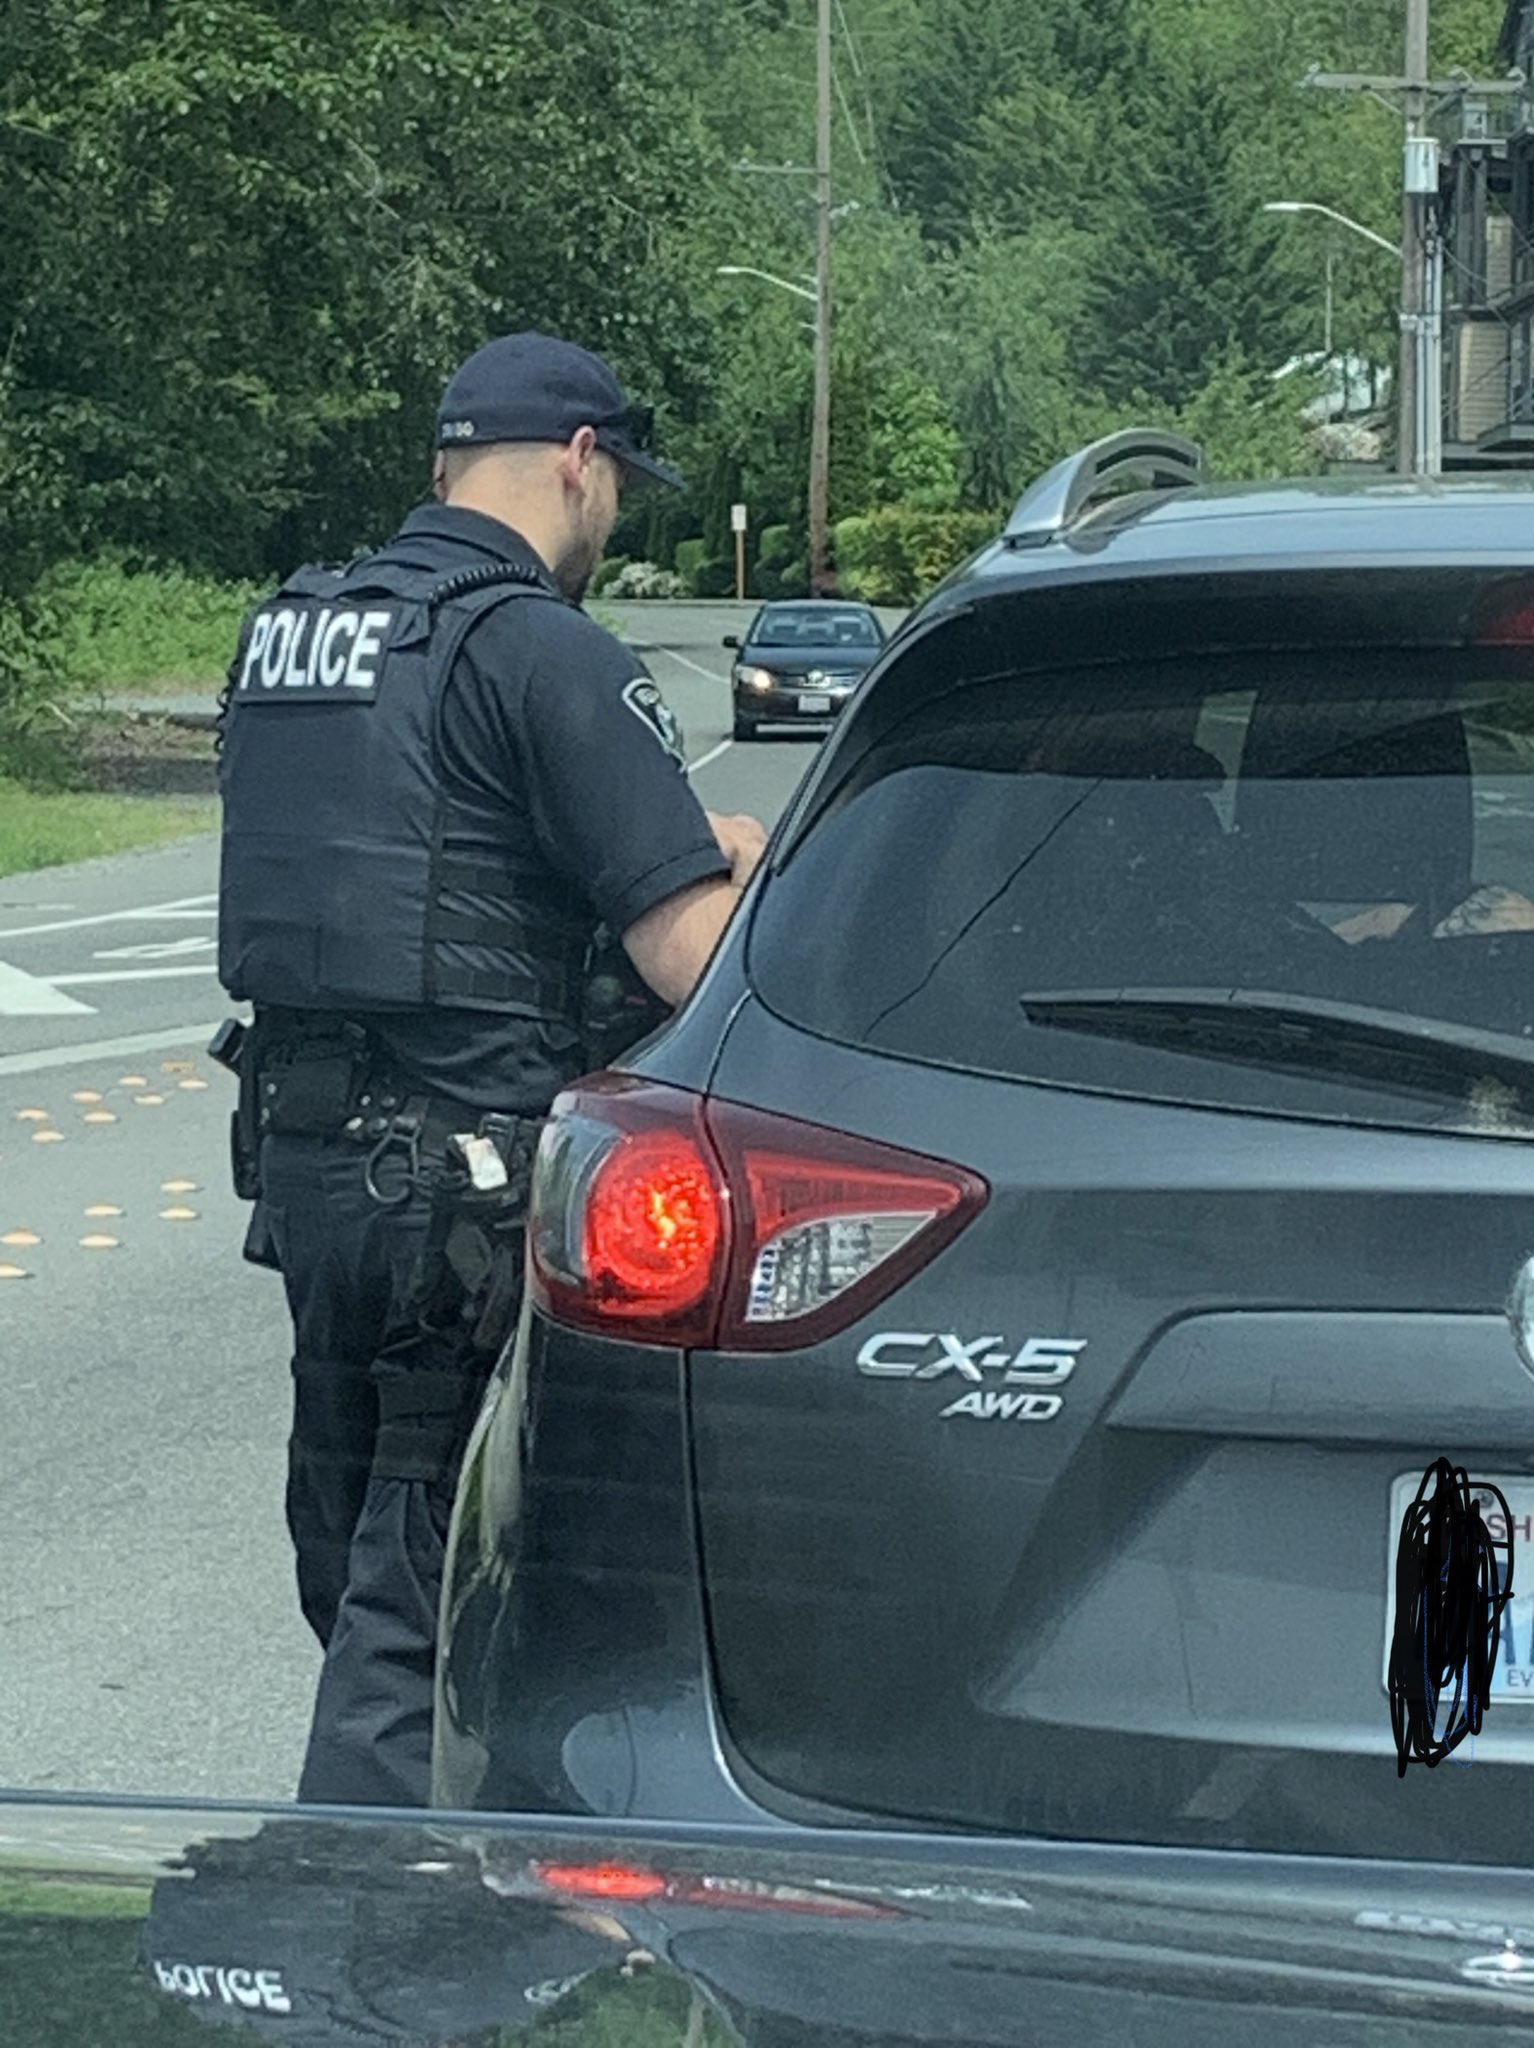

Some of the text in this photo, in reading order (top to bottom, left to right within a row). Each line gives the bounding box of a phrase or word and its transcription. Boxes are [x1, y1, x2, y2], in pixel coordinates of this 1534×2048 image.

[239, 608, 392, 690] POLICE
[855, 1332, 1089, 1386] CX-5
[938, 1391, 1063, 1420] AWD
